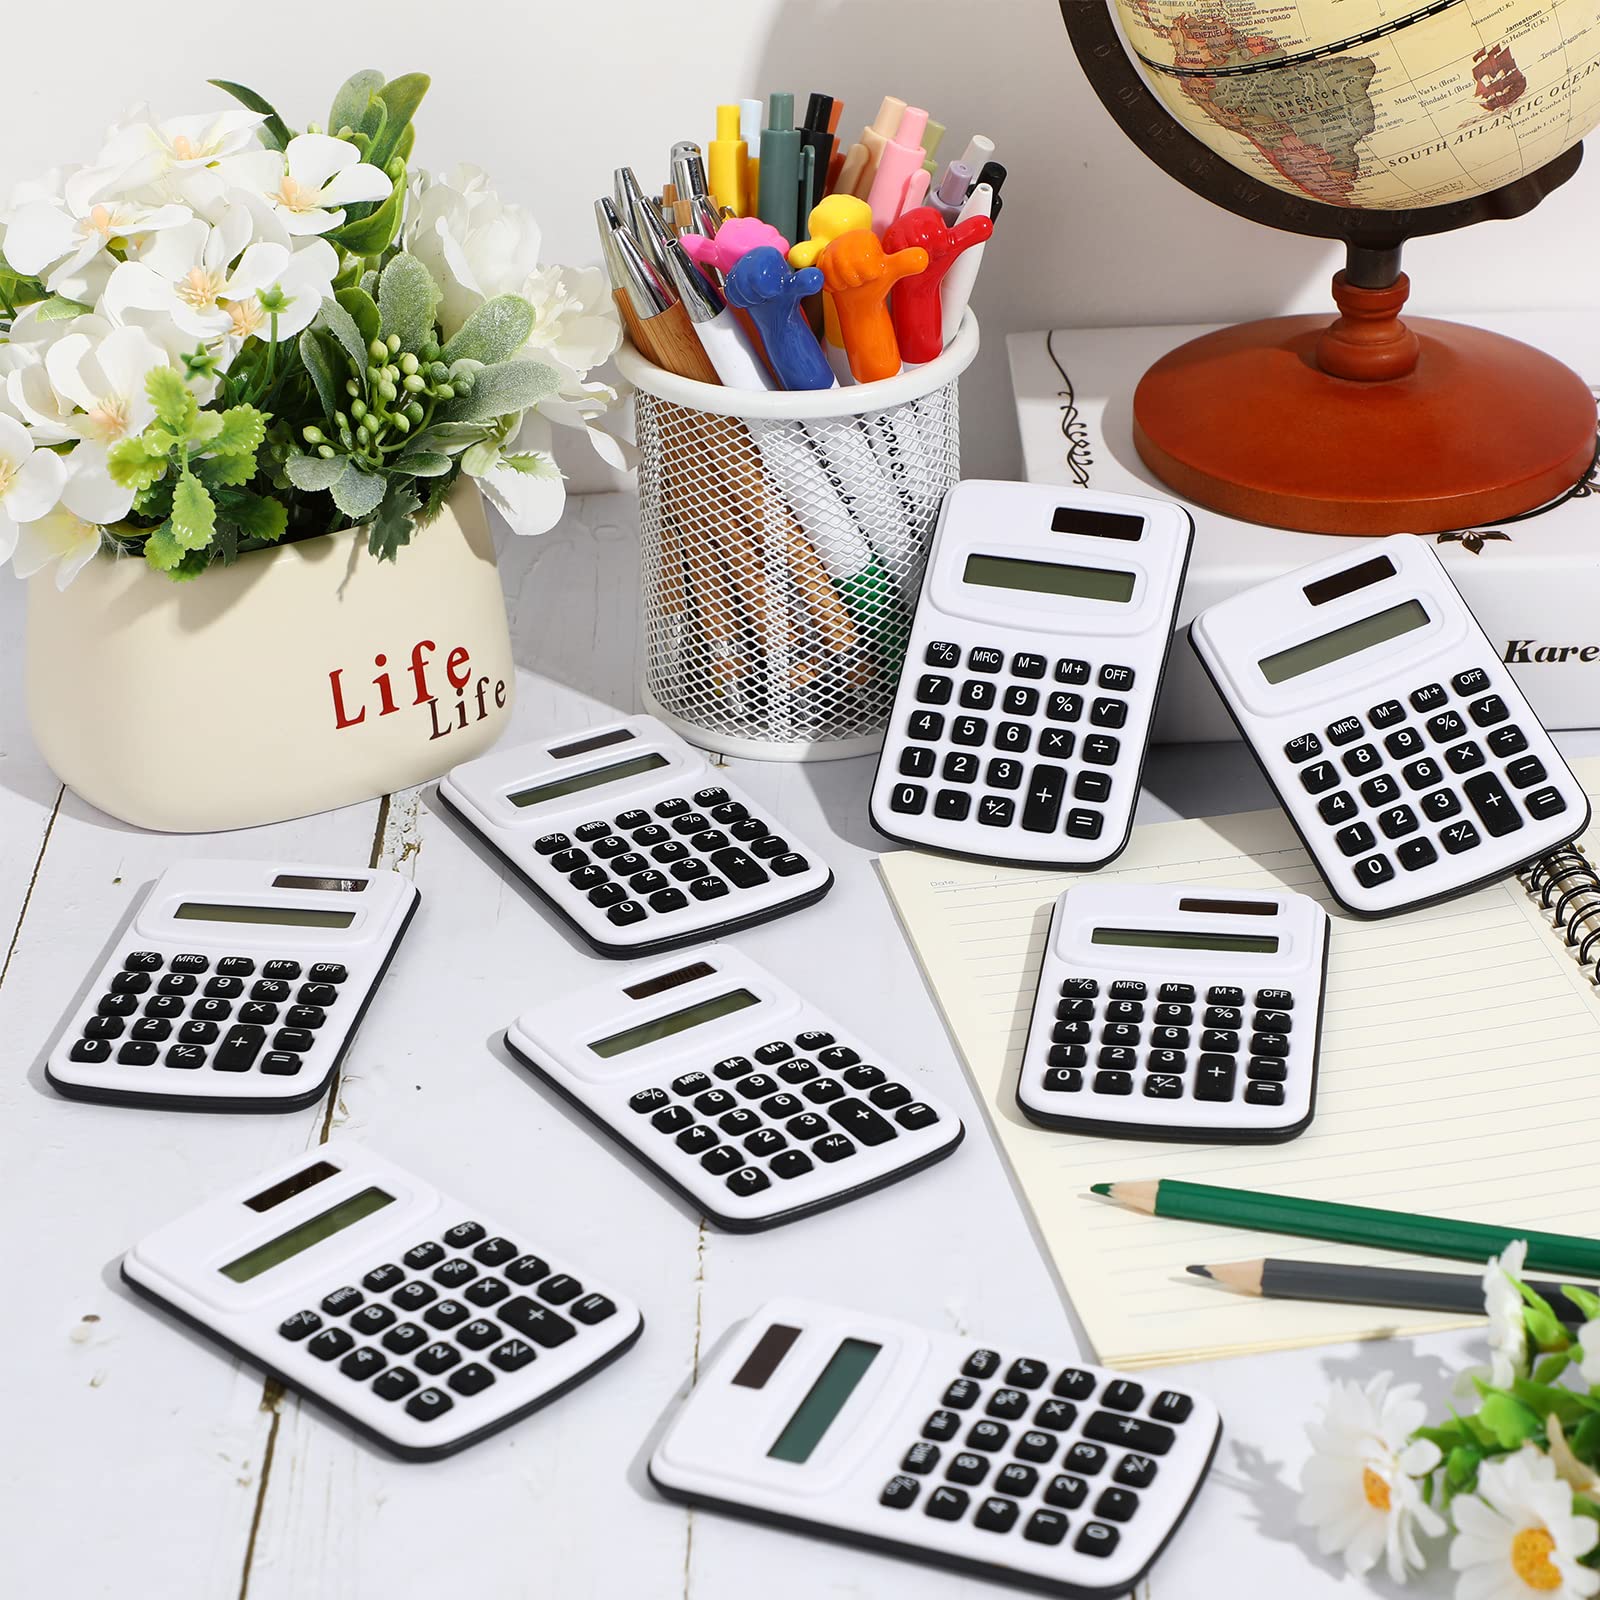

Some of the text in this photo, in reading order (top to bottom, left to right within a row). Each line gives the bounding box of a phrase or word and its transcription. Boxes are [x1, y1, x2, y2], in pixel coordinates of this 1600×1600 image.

[1266, 14, 1291, 23] TOBAGO
[1505, 9, 1542, 33] Jamestown
[1191, 29, 1229, 39] VENEZUELA
[1276, 88, 1340, 110] AMERICA
[1278, 100, 1333, 118] BRAZIL
[1388, 141, 1447, 168] SOUTH
[1454, 96, 1544, 146] ATLANTIC
[1503, 640, 1600, 663] Kare
[329, 640, 472, 730] Life
[929, 678, 1028, 706] 7 8 9
[427, 676, 507, 741] Life
[919, 715, 1020, 742] 4 5 6
[913, 751, 1011, 778] 1 2 3
[1311, 732, 1412, 781] 7 8 9
[902, 788, 915, 804] 0
[1333, 762, 1431, 809] 4 5 6
[1350, 793, 1450, 841] 1 2 3
[562, 826, 658, 859] 7 8 9
[584, 842, 678, 875] 4 5 6
[1367, 859, 1383, 874] 0
[602, 859, 697, 893] 1 2 3
[619, 902, 634, 912] 0
[125, 972, 231, 988] 7 8 9
[110, 994, 219, 1010] 4 5 6
[1070, 999, 1182, 1015] 7 8 9
[99, 1017, 206, 1033] 1 2 3
[1065, 1022, 1178, 1038] 4 5 6
[83, 1040, 98, 1052] 0
[1063, 1045, 1175, 1062] 1 2 3
[1057, 1069, 1071, 1081] 0
[663, 1076, 765, 1119] 7 8 9
[692, 1095, 791, 1138] 4 5 6
[716, 1114, 817, 1158] 1 2 3
[740, 1169, 757, 1181] 0
[321, 1284, 424, 1343] 7 8 9
[357, 1302, 457, 1362] 4 5 6
[389, 1322, 489, 1382] 1 2 3
[420, 1391, 439, 1405] 0
